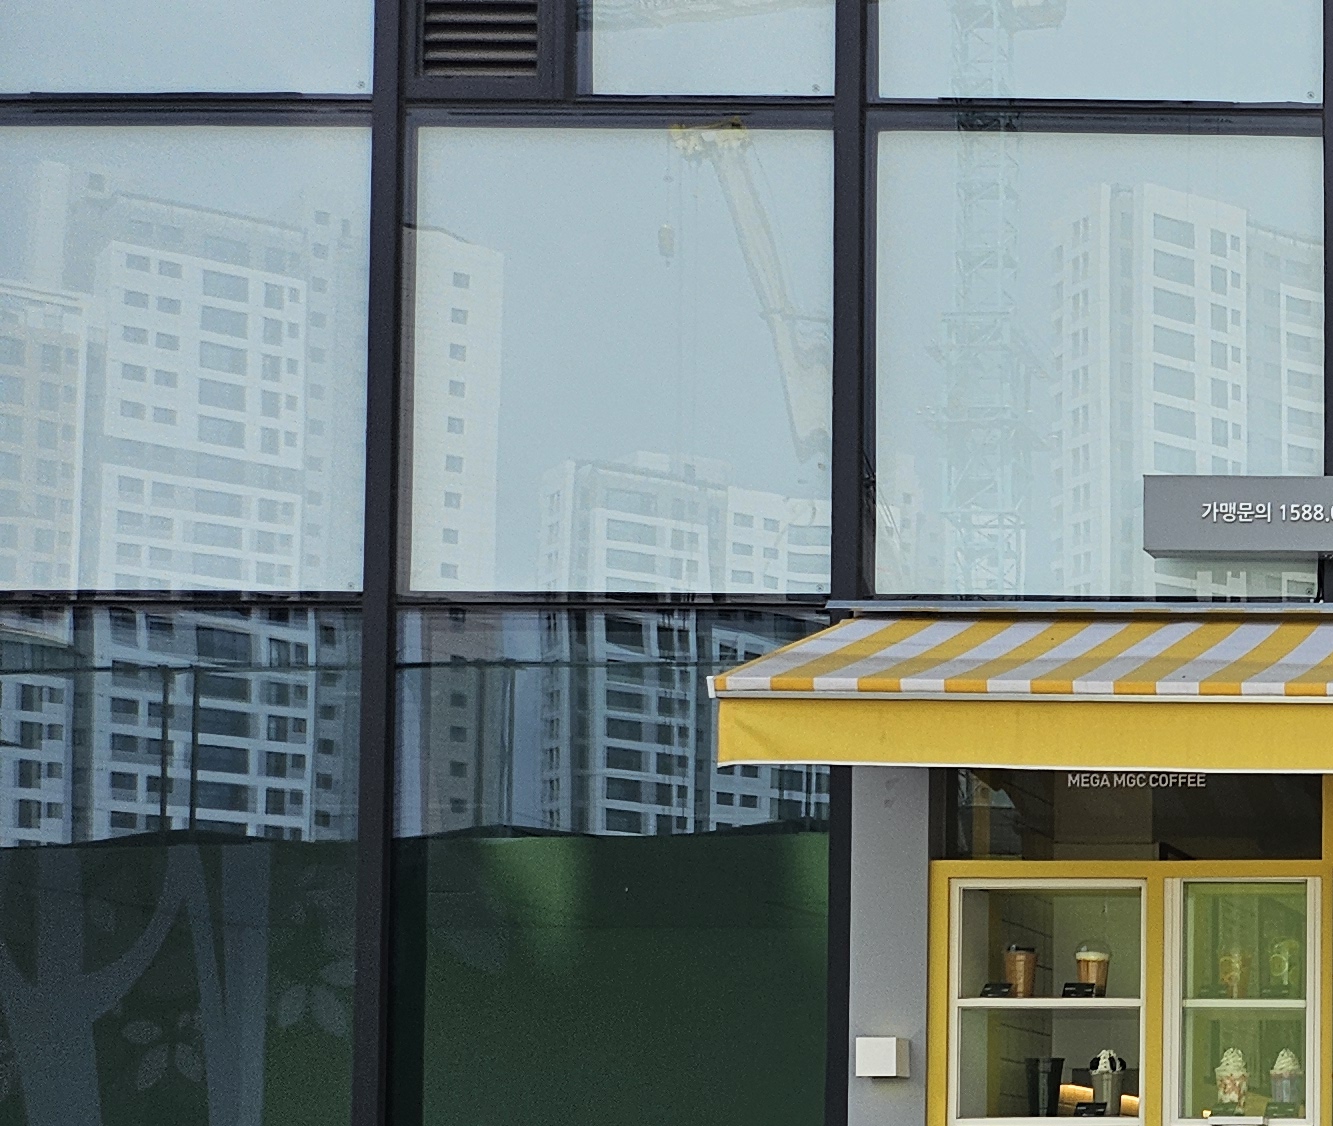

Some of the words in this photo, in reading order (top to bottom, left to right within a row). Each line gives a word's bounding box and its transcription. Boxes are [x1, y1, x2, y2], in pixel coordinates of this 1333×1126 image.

[1201, 502, 1273, 523] 가맹문의
[1067, 773, 1111, 788] MEGA
[1113, 773, 1147, 788] MGC
[1149, 773, 1207, 788] COFFEE
